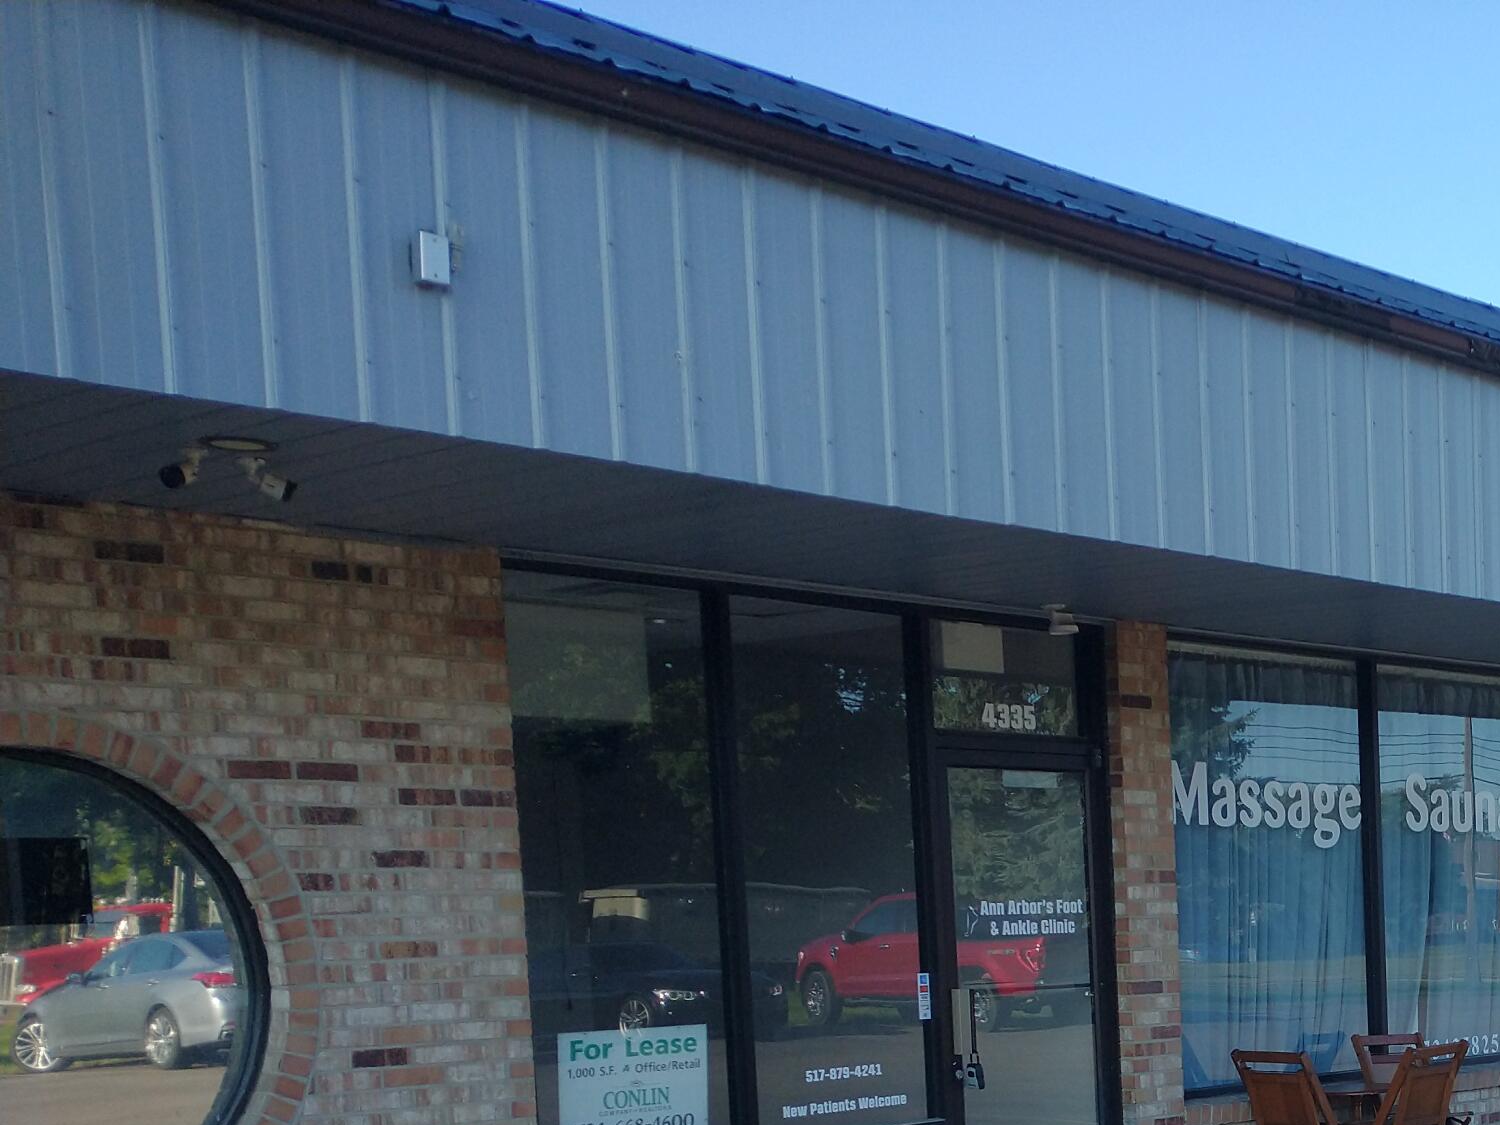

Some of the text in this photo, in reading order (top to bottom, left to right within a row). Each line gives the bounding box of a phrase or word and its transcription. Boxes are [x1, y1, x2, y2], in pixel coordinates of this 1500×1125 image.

[982, 702, 1037, 730] 4335
[1171, 760, 1361, 849] Massage
[980, 899, 1084, 916] Ann Arbor's Foot
[990, 919, 1076, 936] & Ankle Clinic
[570, 1035, 698, 1062] For Lease
[634, 1058, 701, 1073] Office/Retail
[805, 1063, 882, 1082] 517-879-4241
[603, 1087, 671, 1109] CONLIN
[782, 1094, 907, 1119] New Patients Welcome
